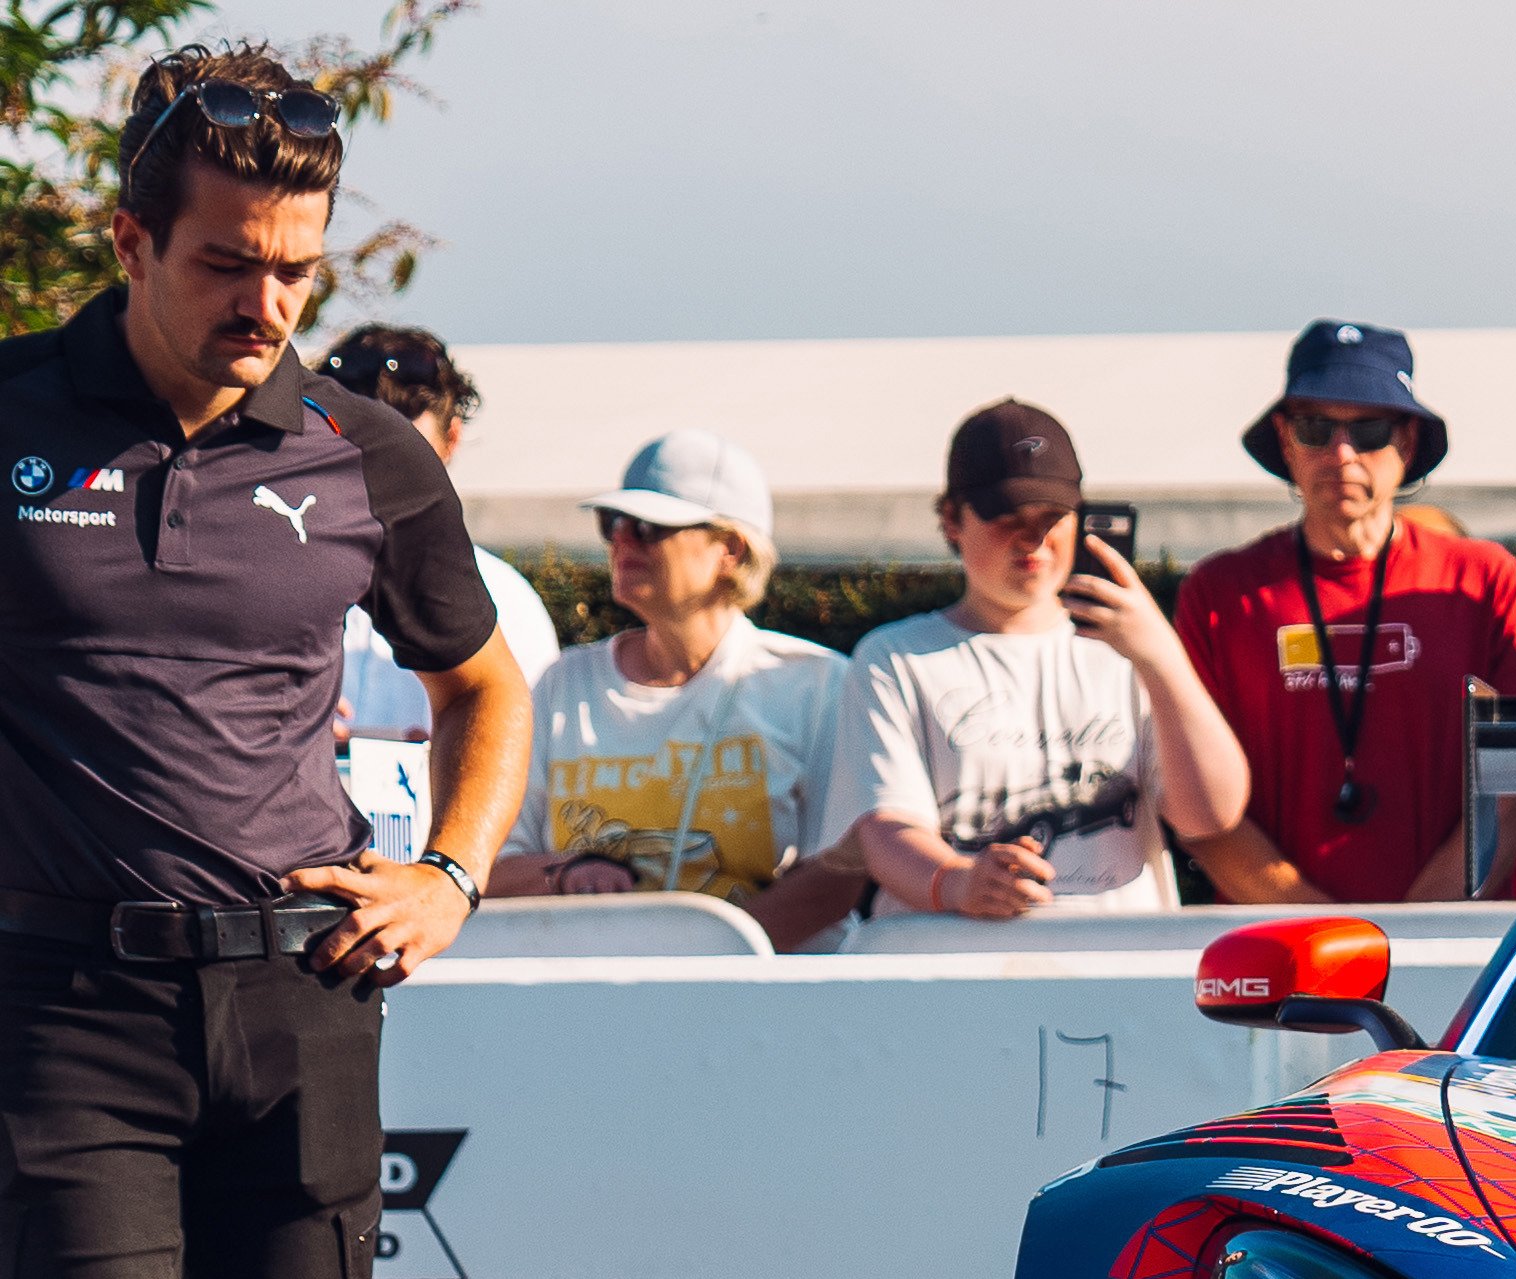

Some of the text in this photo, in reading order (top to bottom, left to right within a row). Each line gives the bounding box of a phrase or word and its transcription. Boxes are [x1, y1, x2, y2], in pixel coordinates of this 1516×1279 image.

[18, 505, 117, 528] Motorsport
[1199, 977, 1270, 998] AMG
[1035, 1024, 1128, 1141] 17
